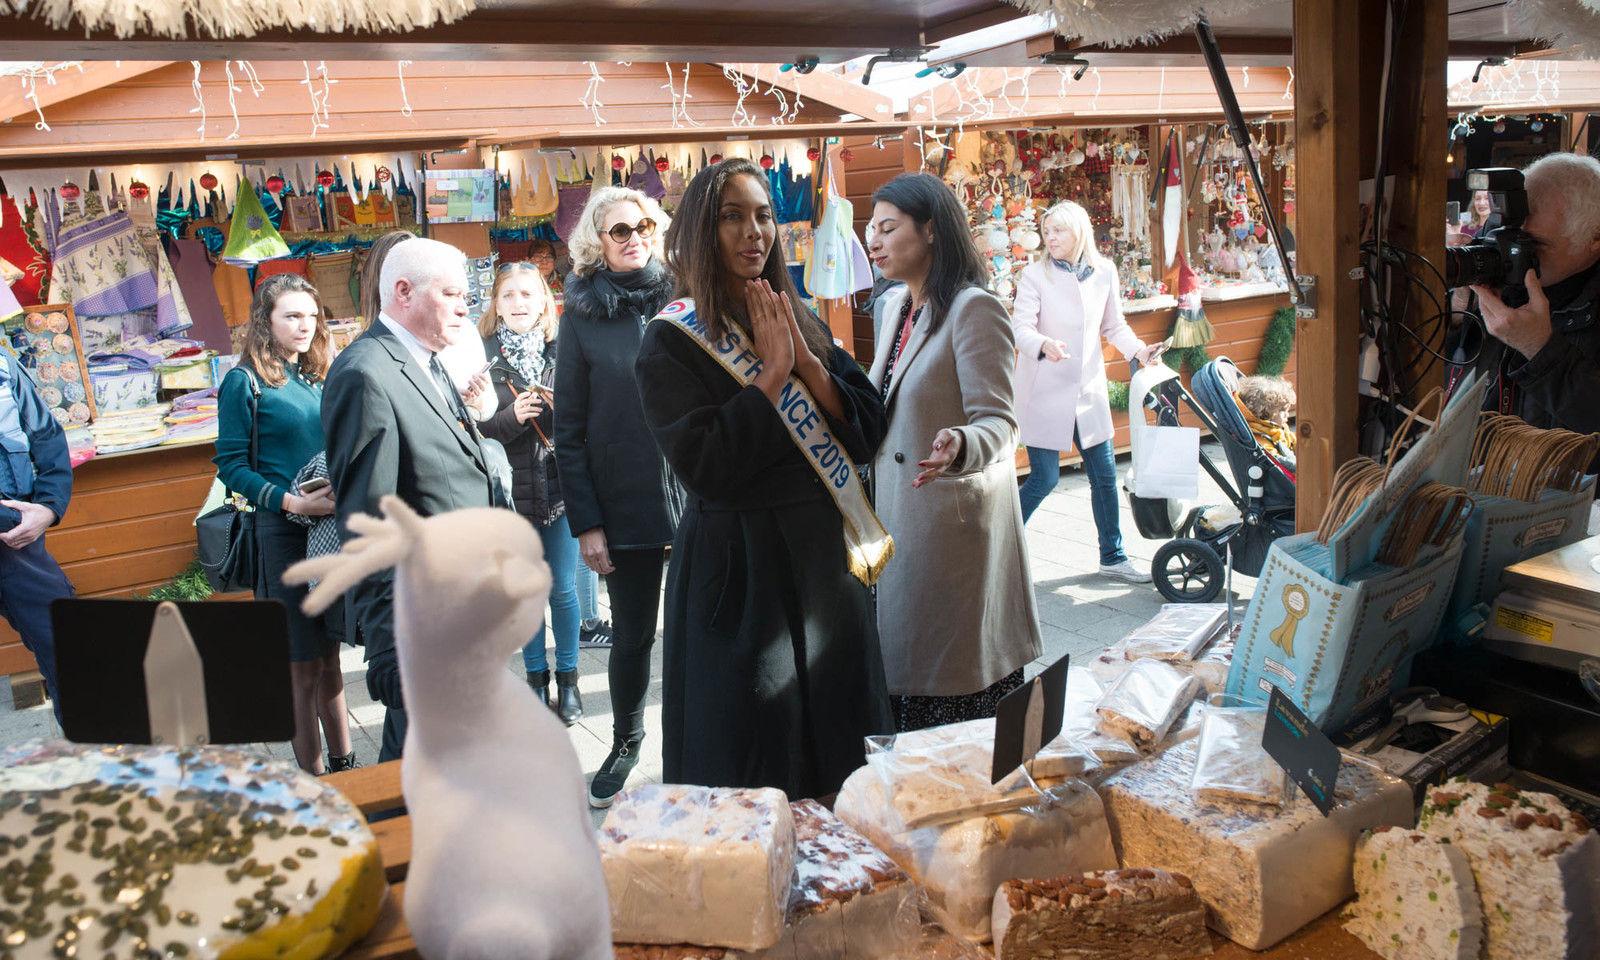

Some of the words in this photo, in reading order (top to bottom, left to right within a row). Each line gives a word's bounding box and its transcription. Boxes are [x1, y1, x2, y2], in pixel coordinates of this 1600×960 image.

[681, 310, 740, 353] MIS
[733, 348, 820, 440] FRNCE
[810, 432, 850, 489] 2019
